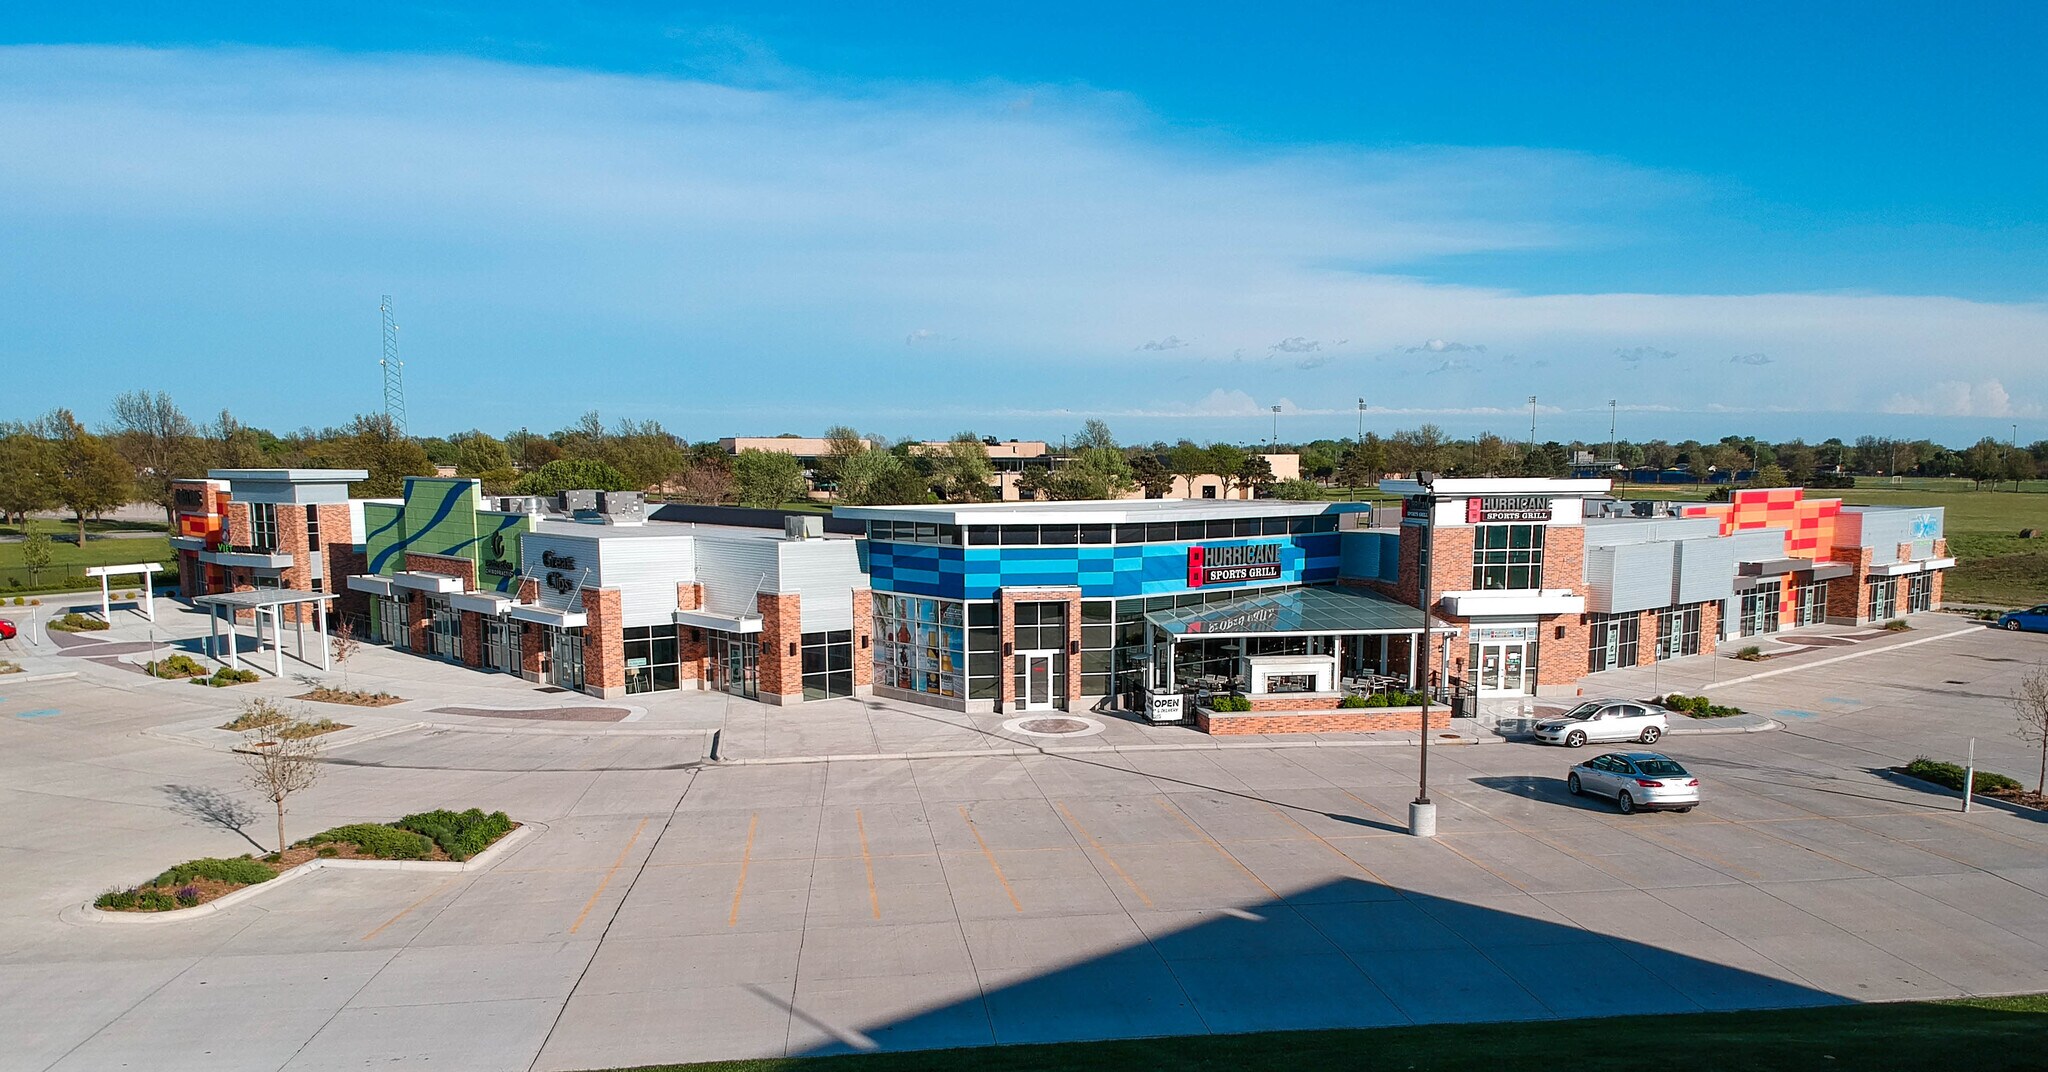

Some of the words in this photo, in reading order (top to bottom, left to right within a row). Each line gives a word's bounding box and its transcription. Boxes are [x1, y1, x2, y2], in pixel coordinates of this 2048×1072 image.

[1482, 497, 1553, 510] HURRICANE
[1487, 512, 1520, 520] SPORTS
[1204, 544, 1282, 567] HURRICANE
[1210, 569, 1247, 580] SPORTS
[1249, 567, 1277, 578] GRILL
[1154, 699, 1179, 708] OPEN
